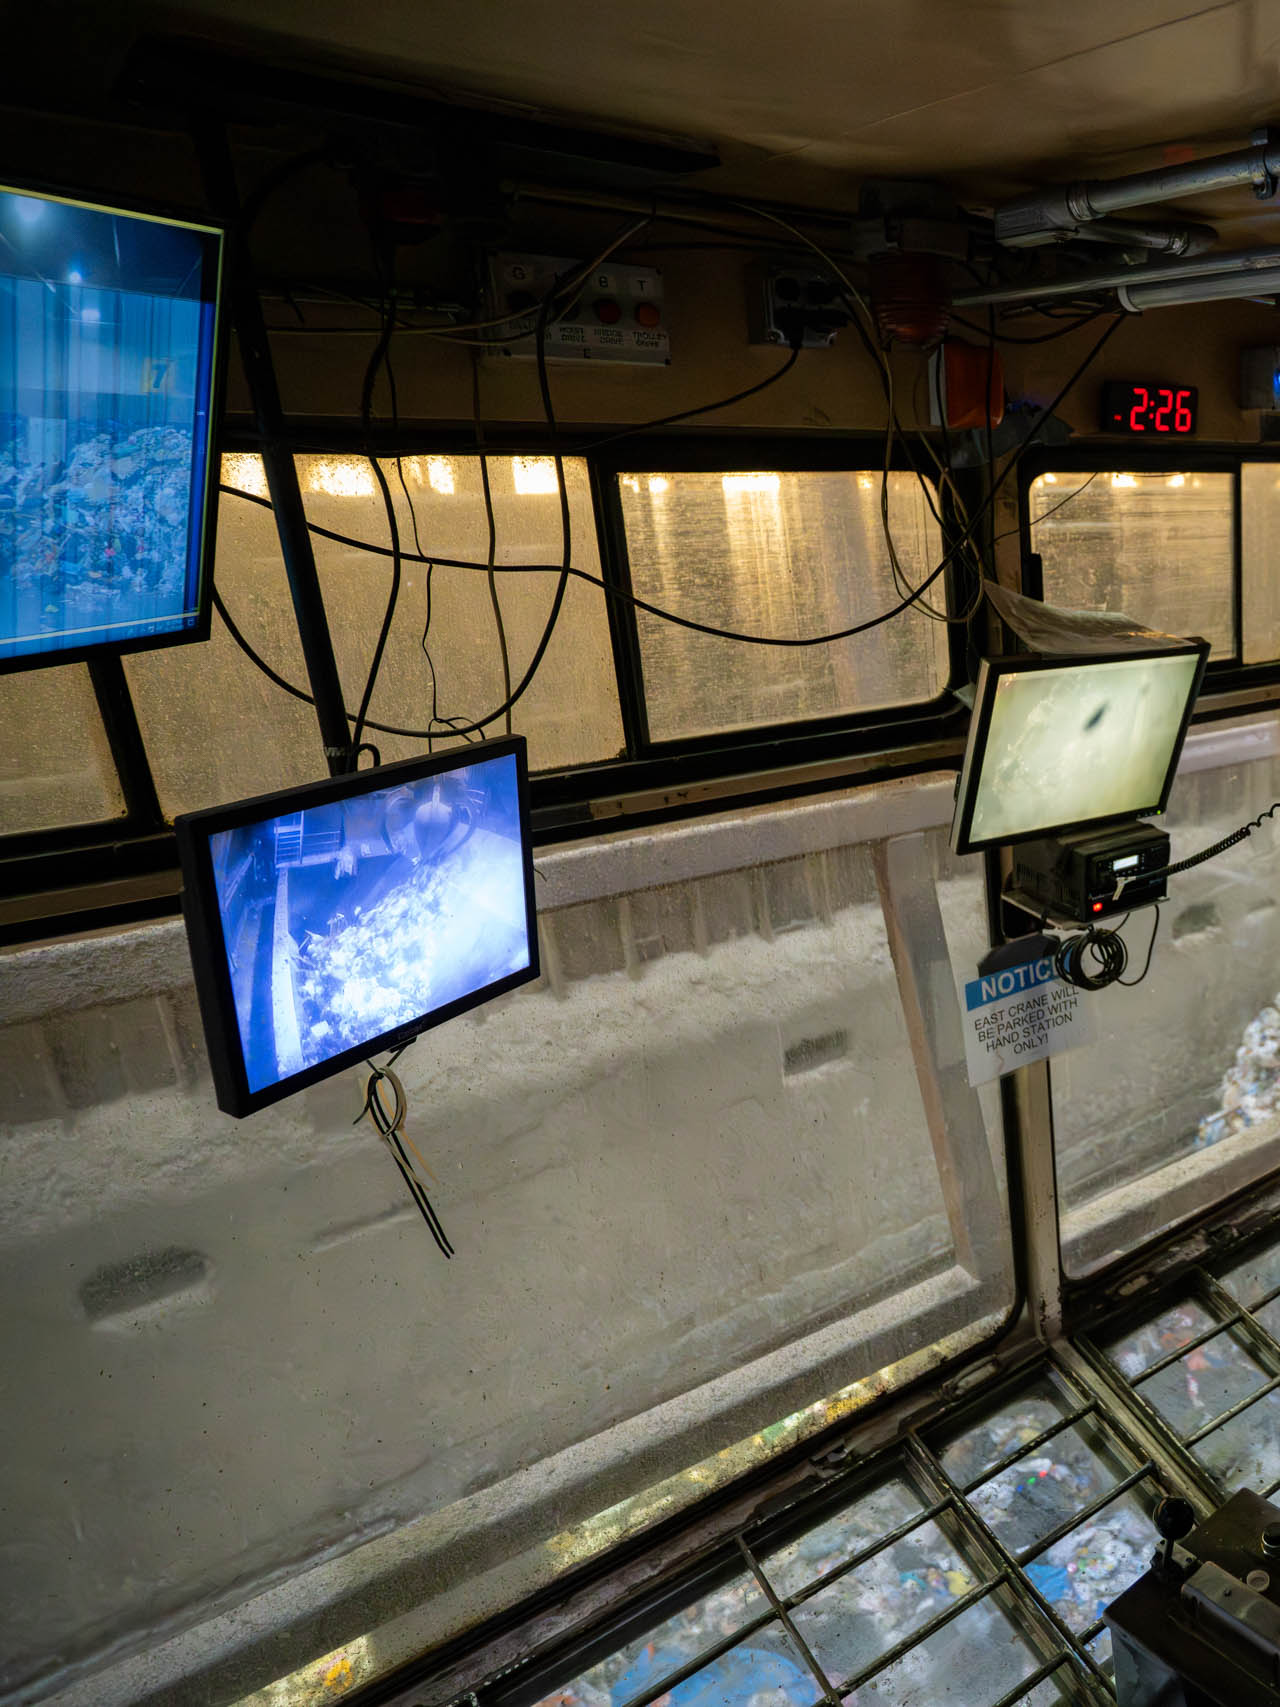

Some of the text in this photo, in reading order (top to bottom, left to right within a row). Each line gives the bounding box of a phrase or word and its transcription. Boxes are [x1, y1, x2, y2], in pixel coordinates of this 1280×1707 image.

[637, 279, 648, 292] T
[151, 363, 169, 389] 7
[1130, 388, 1192, 431] 2:26
[974, 986, 1079, 1031] EAST CRANE WILL
[978, 998, 1078, 1042] BE PARKED WITH
[986, 1012, 1073, 1053] HAND STATION
[1013, 1033, 1049, 1054] ONLY!
